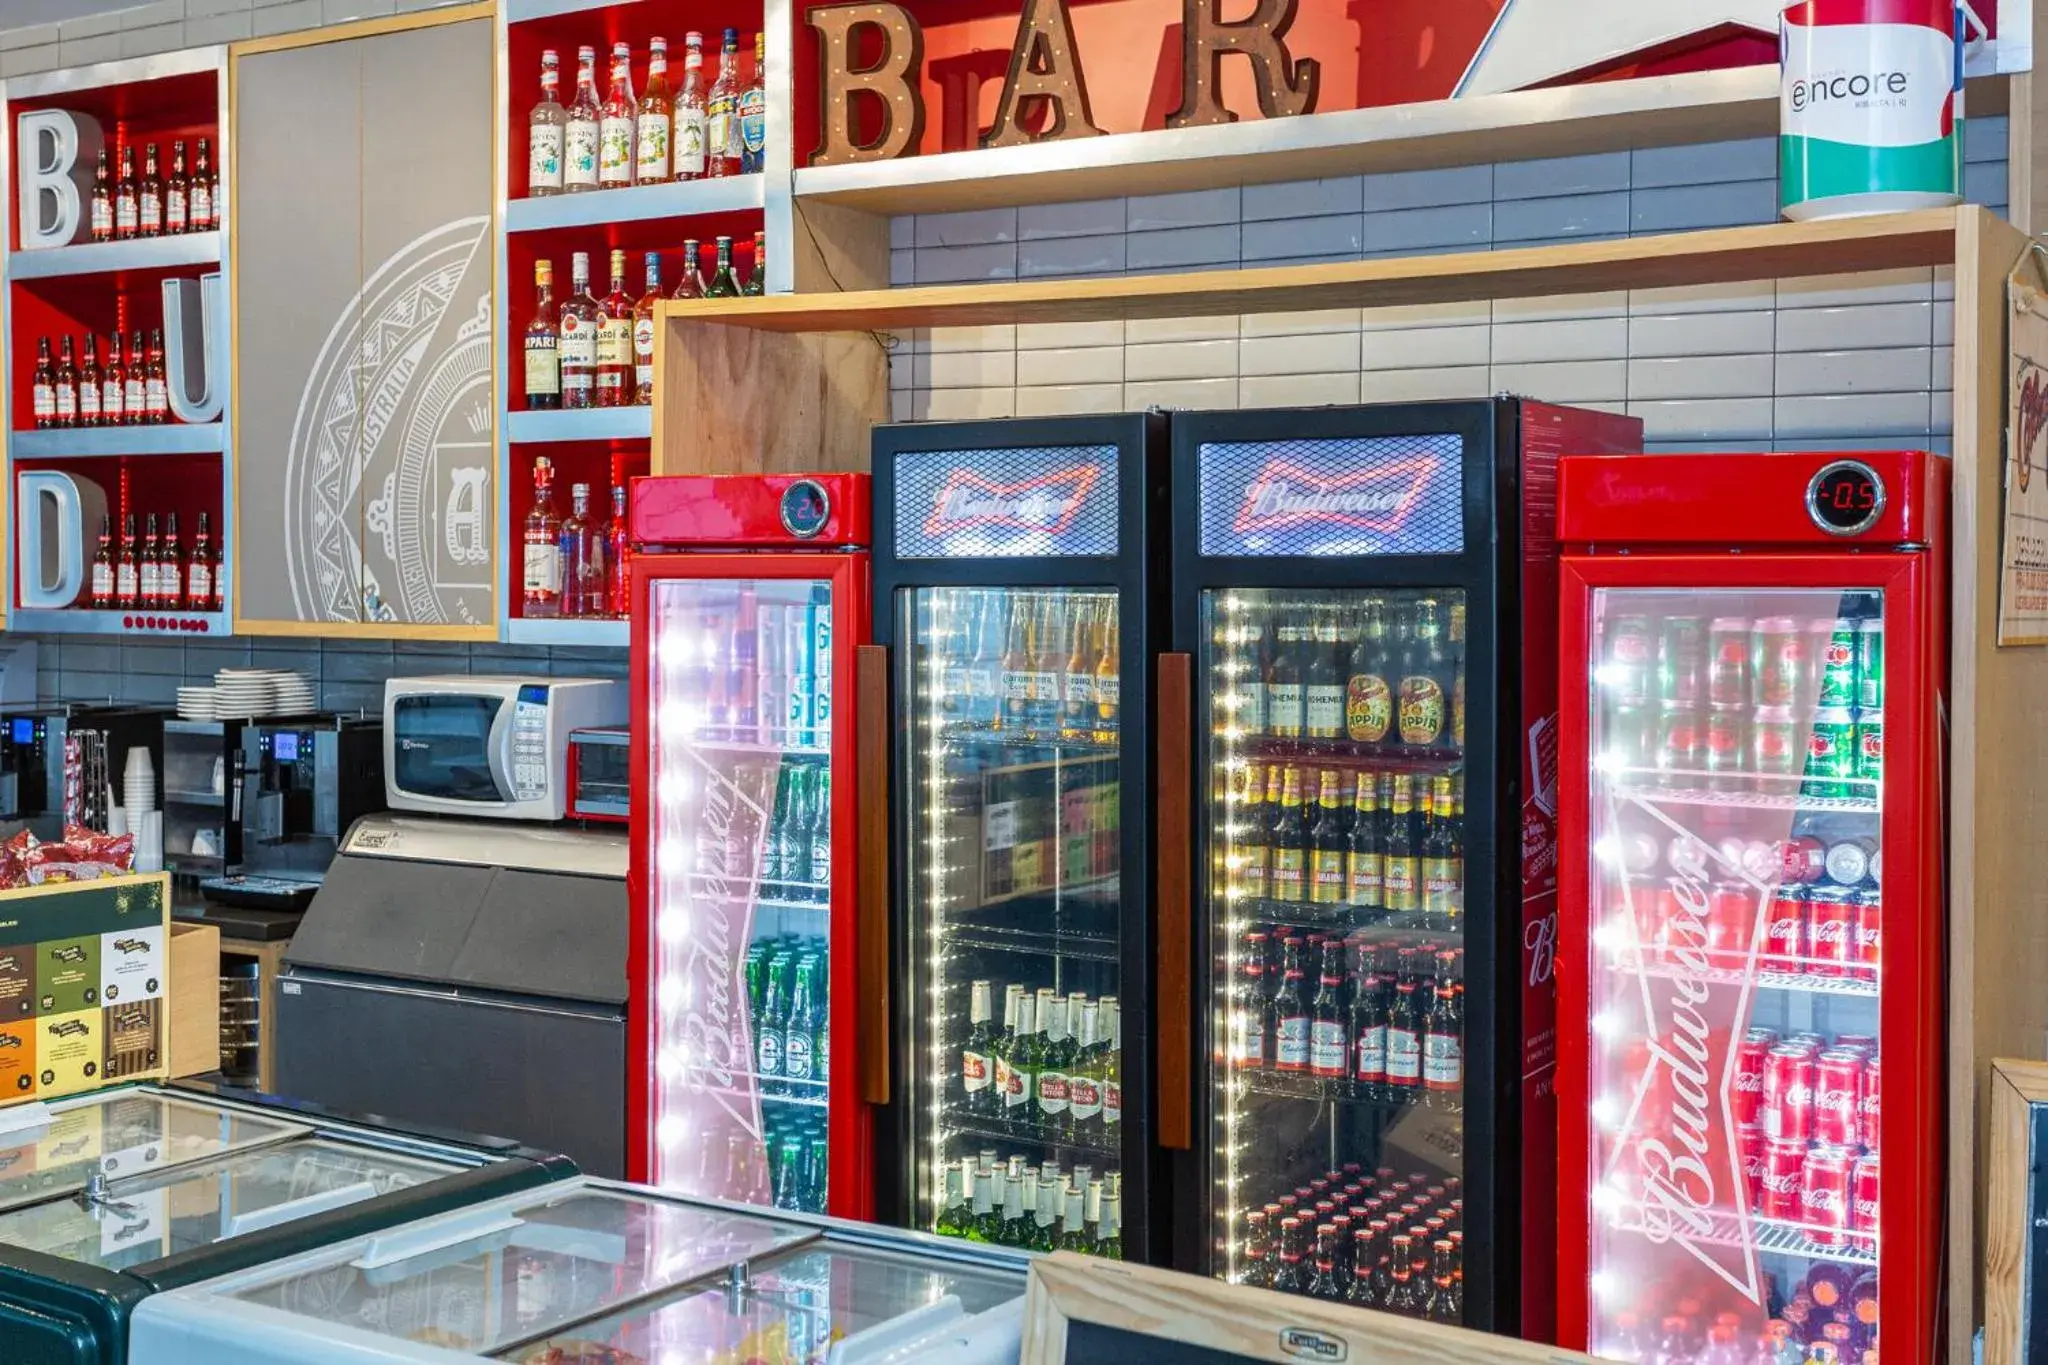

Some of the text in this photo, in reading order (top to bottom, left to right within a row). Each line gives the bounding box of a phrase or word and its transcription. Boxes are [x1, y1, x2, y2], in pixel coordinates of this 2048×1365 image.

[1792, 72, 1907, 112] encore
[358, 357, 415, 463] AUSTRALIA
[1640, 834, 1715, 1245] Budweiser
